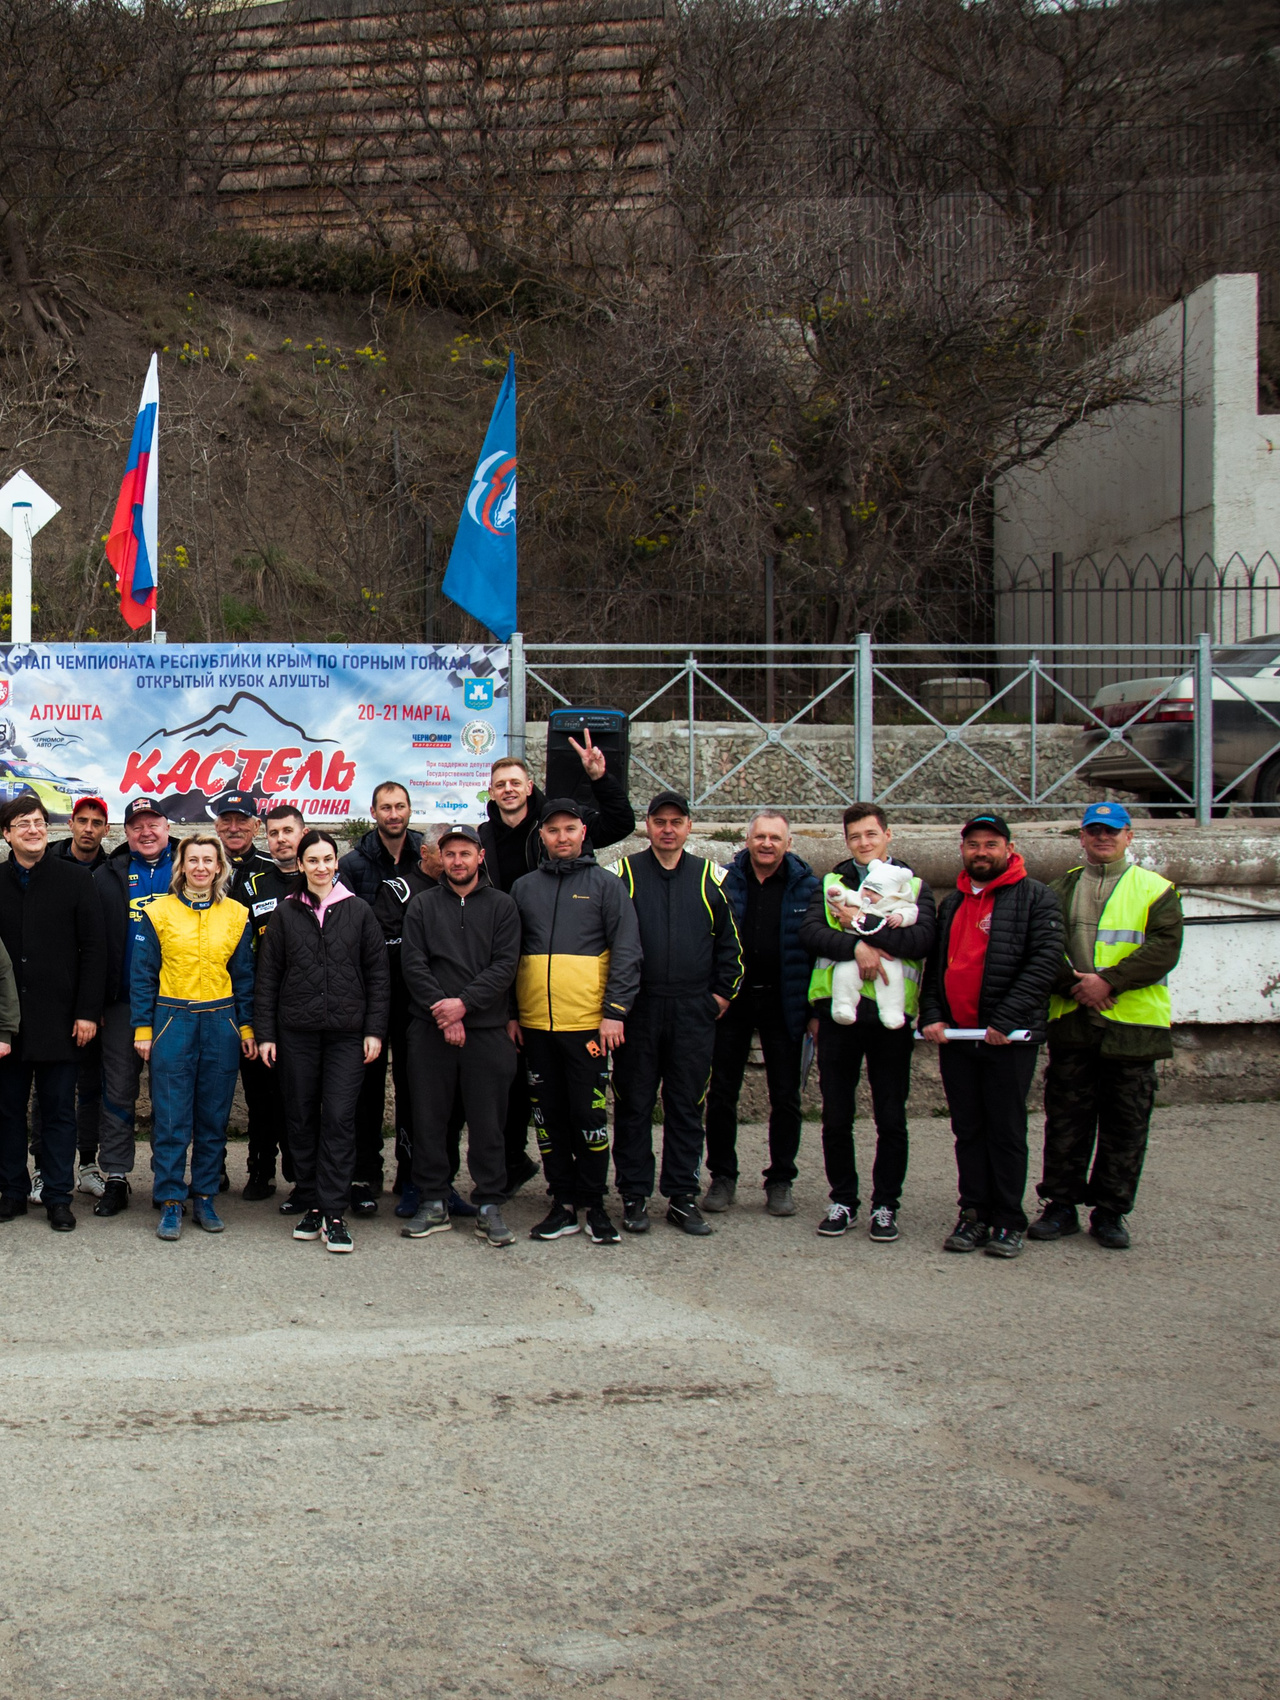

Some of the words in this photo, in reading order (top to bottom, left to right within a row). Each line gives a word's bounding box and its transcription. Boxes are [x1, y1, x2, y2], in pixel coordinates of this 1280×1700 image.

[13, 655, 51, 669] ЭТАП
[56, 654, 156, 669] ЧЕМПИОНАТА
[160, 653, 262, 669] РЕСПУБЛИКИ
[267, 653, 312, 669] КРЫМ
[317, 654, 337, 669] ПО
[343, 654, 406, 670] ГОРНЫМ
[411, 655, 472, 671] ГОНКАМ
[136, 671, 215, 688] ОТКРЫТЫЙ
[219, 674, 264, 688] КУБОК
[268, 674, 330, 688] АЛУШТЫ
[29, 704, 103, 721] АЛУШТА
[358, 704, 398, 721] 20-21
[402, 704, 451, 721] МАРТА
[119, 747, 357, 796] КАСТЕЛЬ
[302, 798, 351, 815] ГОНКА
[435, 801, 468, 810] kalipso
